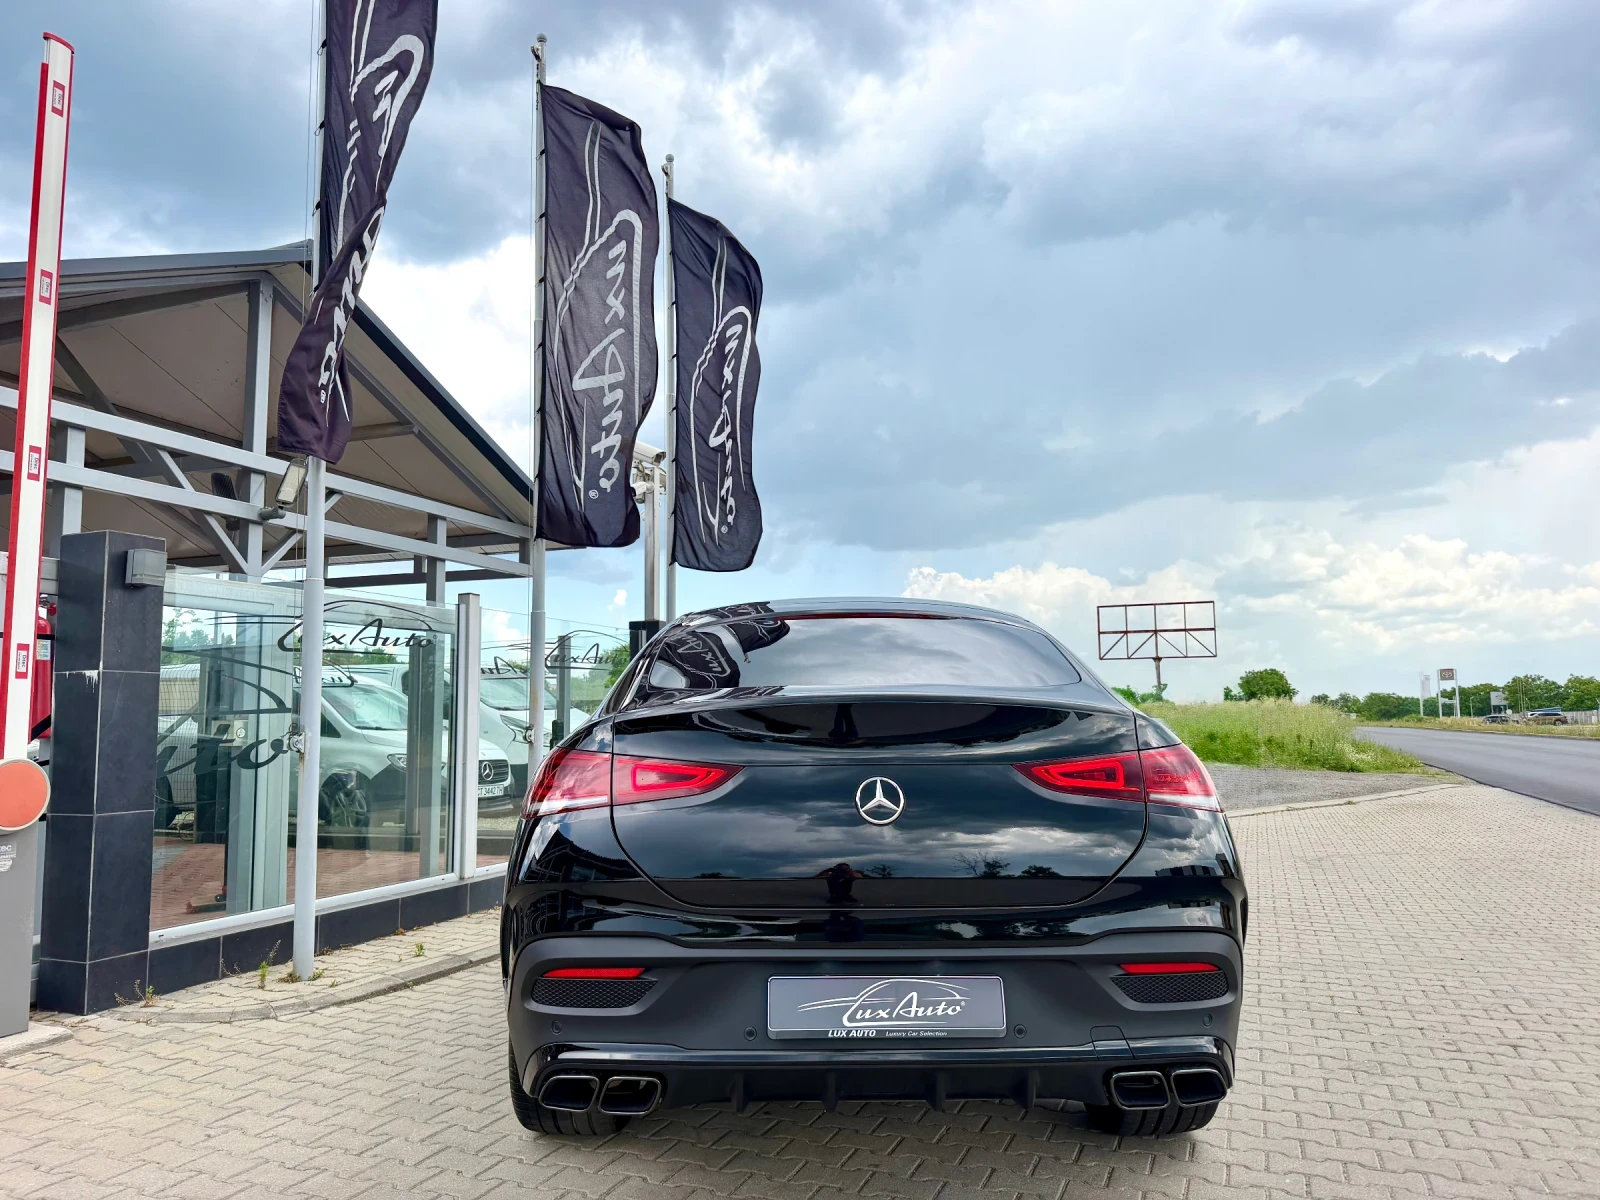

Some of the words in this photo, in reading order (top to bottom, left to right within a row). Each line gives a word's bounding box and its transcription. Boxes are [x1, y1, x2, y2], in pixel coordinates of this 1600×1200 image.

[277, 606, 347, 652] Lx
[842, 989, 891, 1027] Lux
[828, 1029, 847, 1037] LUX
[849, 1029, 876, 1037] AUTO
